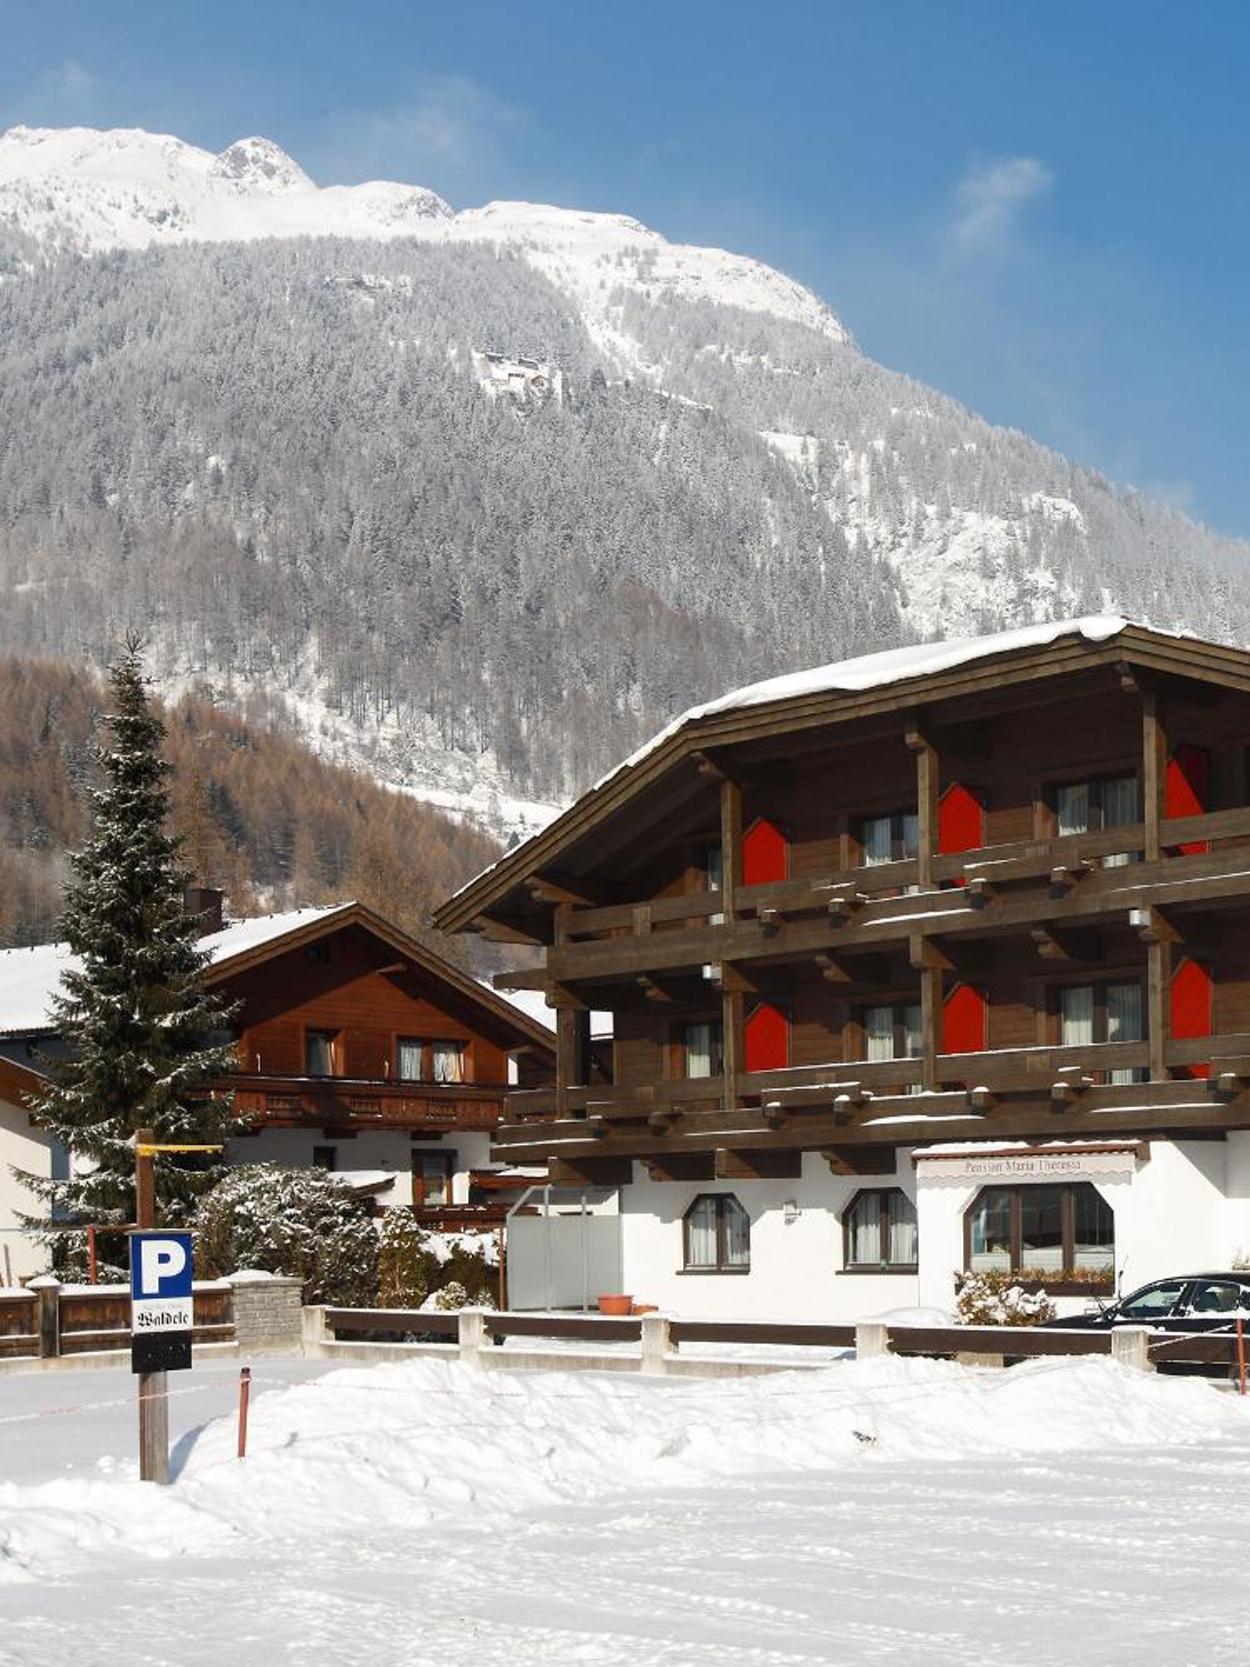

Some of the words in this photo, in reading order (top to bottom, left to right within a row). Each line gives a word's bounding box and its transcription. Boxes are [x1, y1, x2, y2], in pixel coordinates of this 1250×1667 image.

[965, 1160, 1002, 1173] Pension
[1006, 1160, 1034, 1172] Maria
[141, 1240, 186, 1294] P
